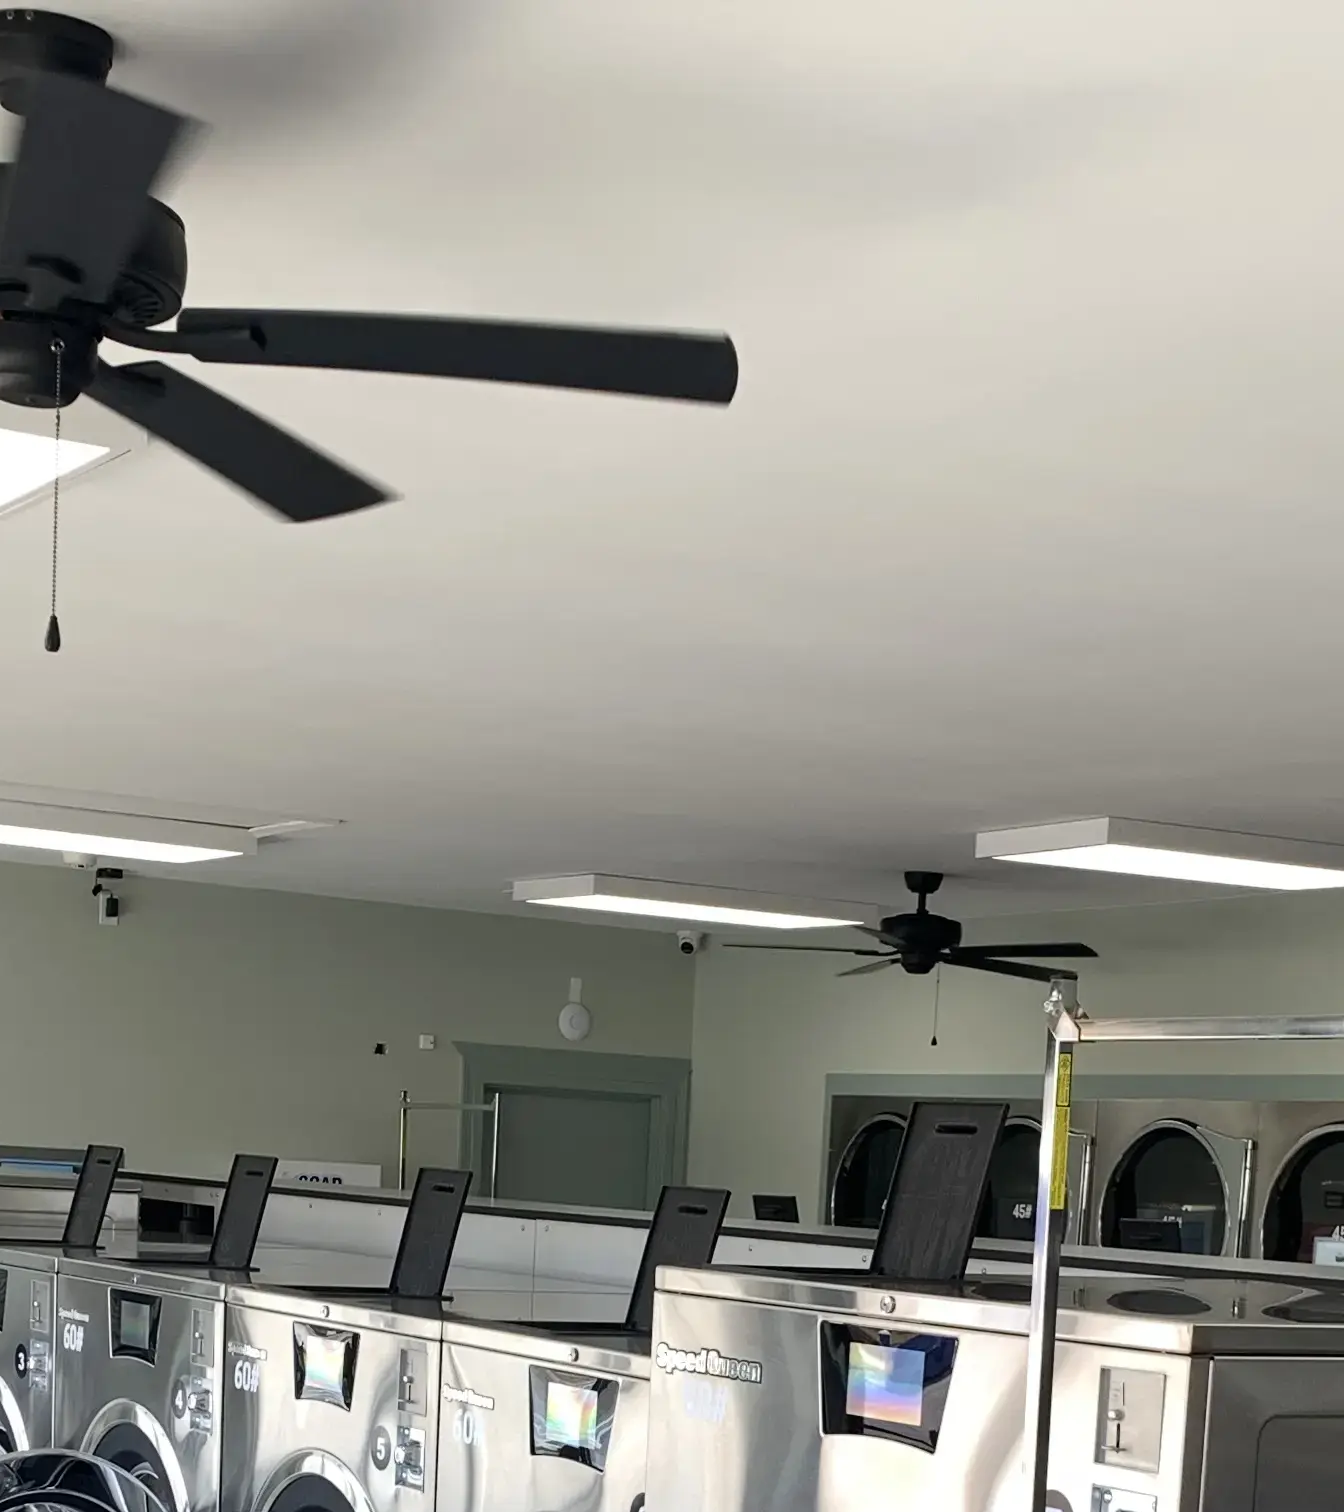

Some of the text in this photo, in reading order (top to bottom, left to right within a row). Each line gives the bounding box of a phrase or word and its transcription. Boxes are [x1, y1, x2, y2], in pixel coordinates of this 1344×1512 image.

[1012, 1203, 1032, 1219] 45#
[63, 1323, 84, 1352] 60#
[17, 1352, 26, 1371] 3
[234, 1360, 259, 1393] 60#
[174, 1388, 184, 1410] 4
[375, 1437, 386, 1461] 5
